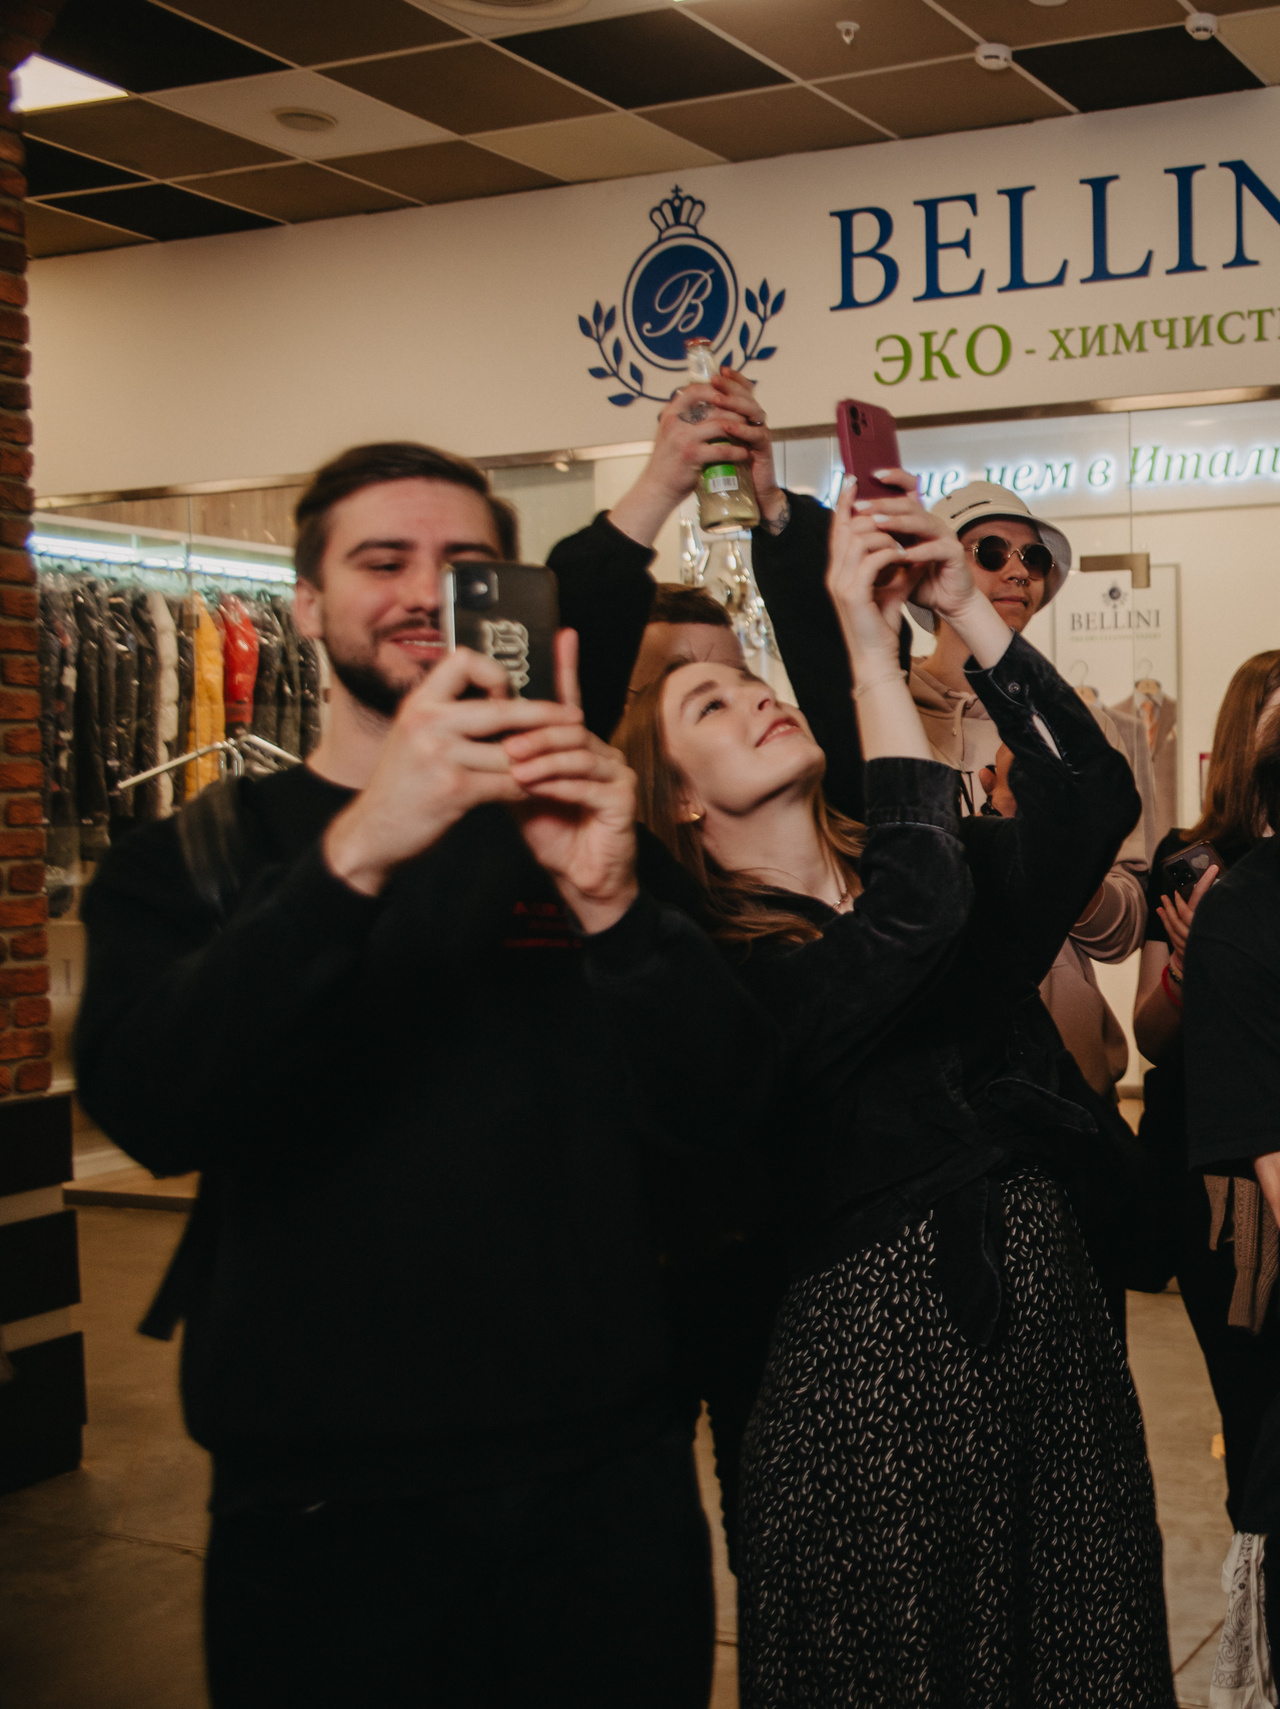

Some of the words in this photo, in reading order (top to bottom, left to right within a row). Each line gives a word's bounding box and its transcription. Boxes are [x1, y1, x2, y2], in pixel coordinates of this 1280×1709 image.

[873, 324, 1013, 386] ЭКО
[985, 462, 1073, 492] чем
[1087, 458, 1111, 488] в
[1070, 608, 1161, 631] BELLINI
